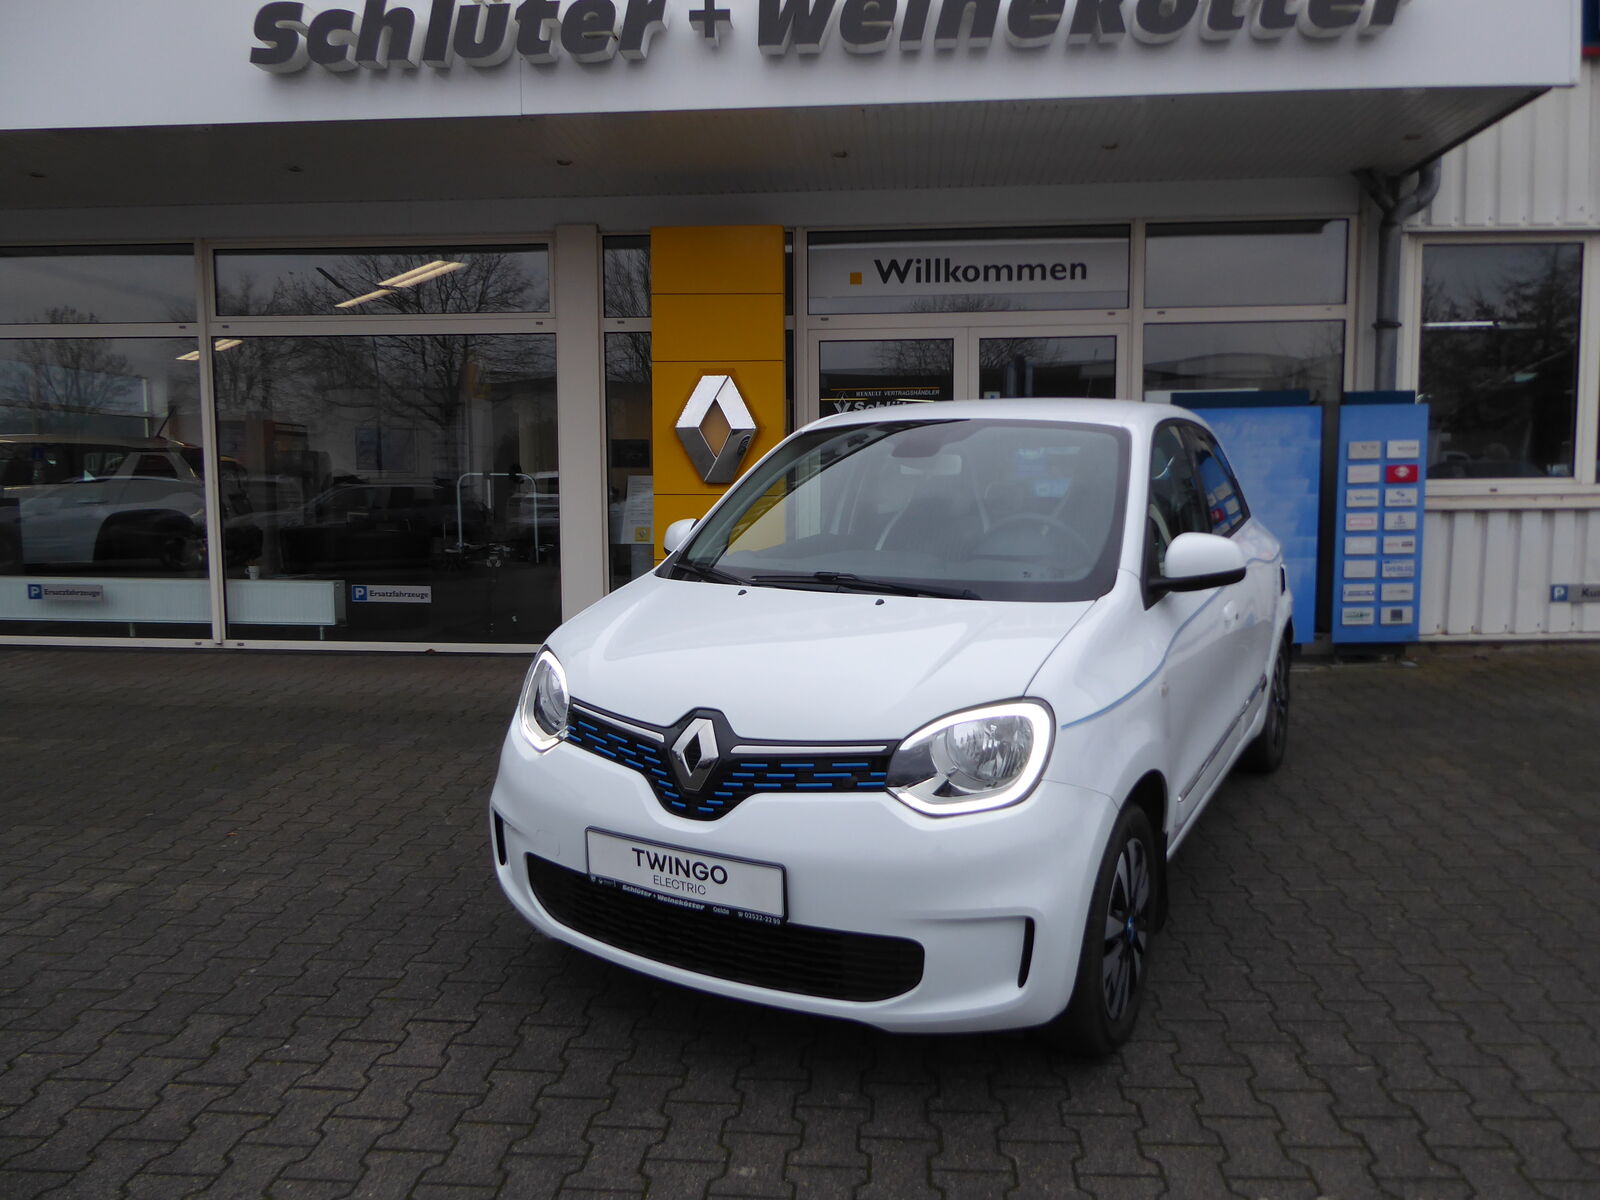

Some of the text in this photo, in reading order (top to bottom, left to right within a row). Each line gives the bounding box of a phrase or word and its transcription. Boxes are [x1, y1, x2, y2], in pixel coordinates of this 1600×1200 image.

[873, 257, 1087, 285] Willkommen
[883, 389, 941, 397] VERTRAGSHÄNDLER
[369, 589, 429, 600] Ersatzfahrzeuge
[631, 847, 728, 885] TWINGO
[653, 874, 707, 896] ELECTRIC
[622, 884, 652, 898] Schlüter
[657, 893, 706, 911] Weinekötter
